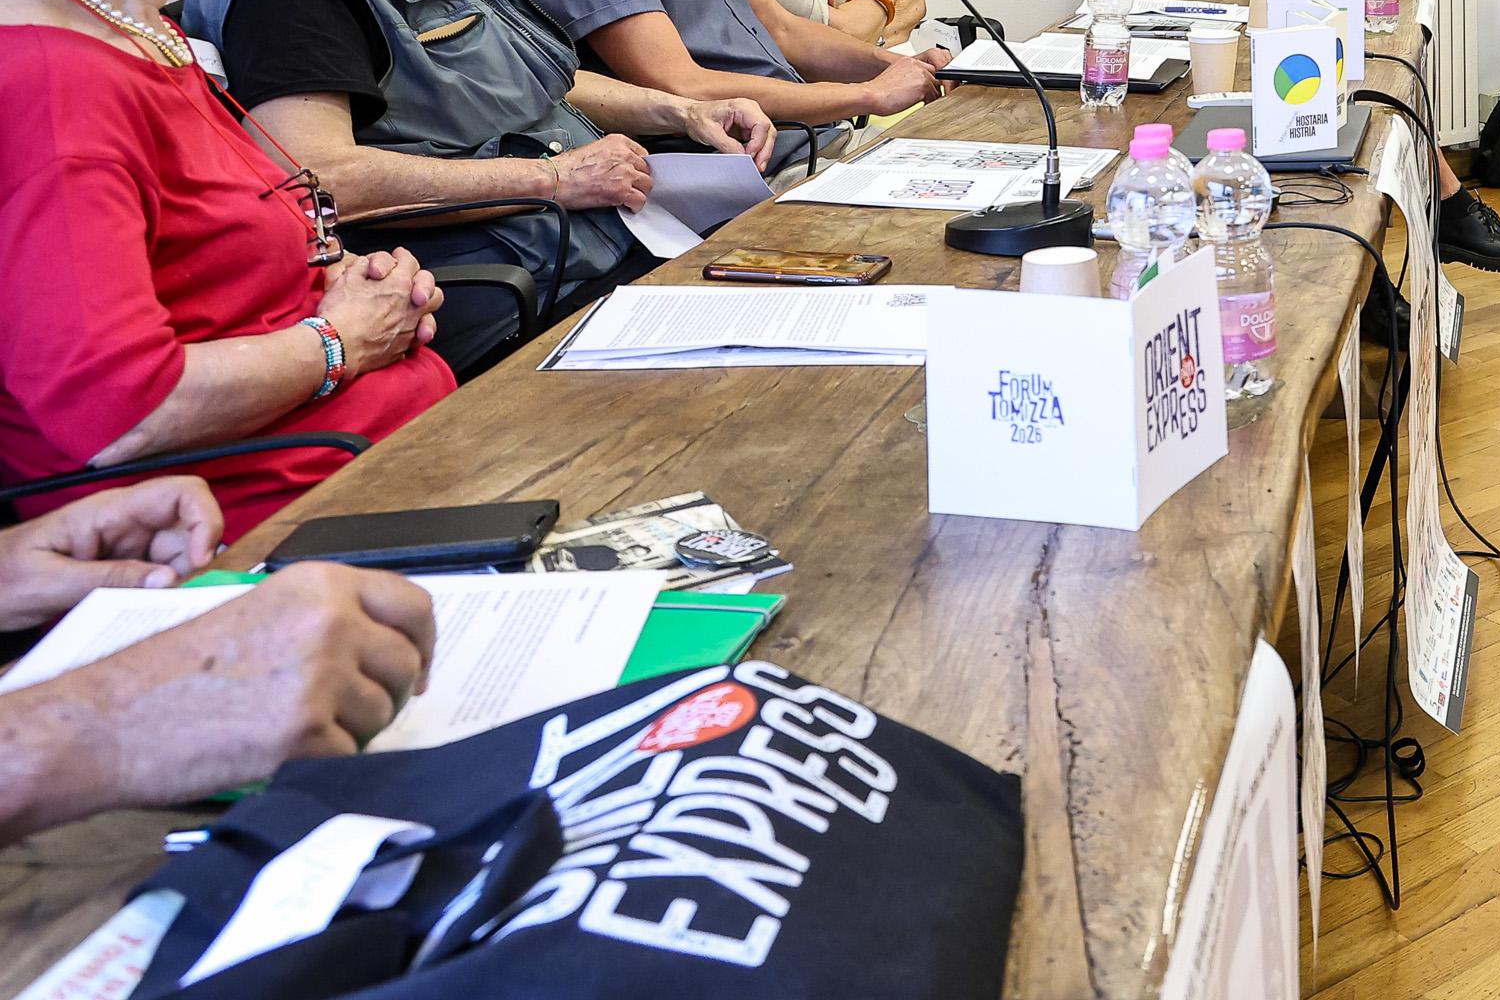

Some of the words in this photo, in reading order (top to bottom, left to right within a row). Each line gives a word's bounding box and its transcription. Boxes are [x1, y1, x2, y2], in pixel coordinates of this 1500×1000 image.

[1289, 125, 1316, 139] HISTRIA
[1295, 112, 1329, 127] HOSTARIA
[1144, 306, 1201, 404] ORIENT
[999, 370, 1054, 400] FORUM
[988, 391, 1065, 426] TOMIZZA
[1146, 369, 1207, 453] EXPRESS
[1010, 423, 1042, 444] 2026
[578, 660, 900, 967] EXPRESS
